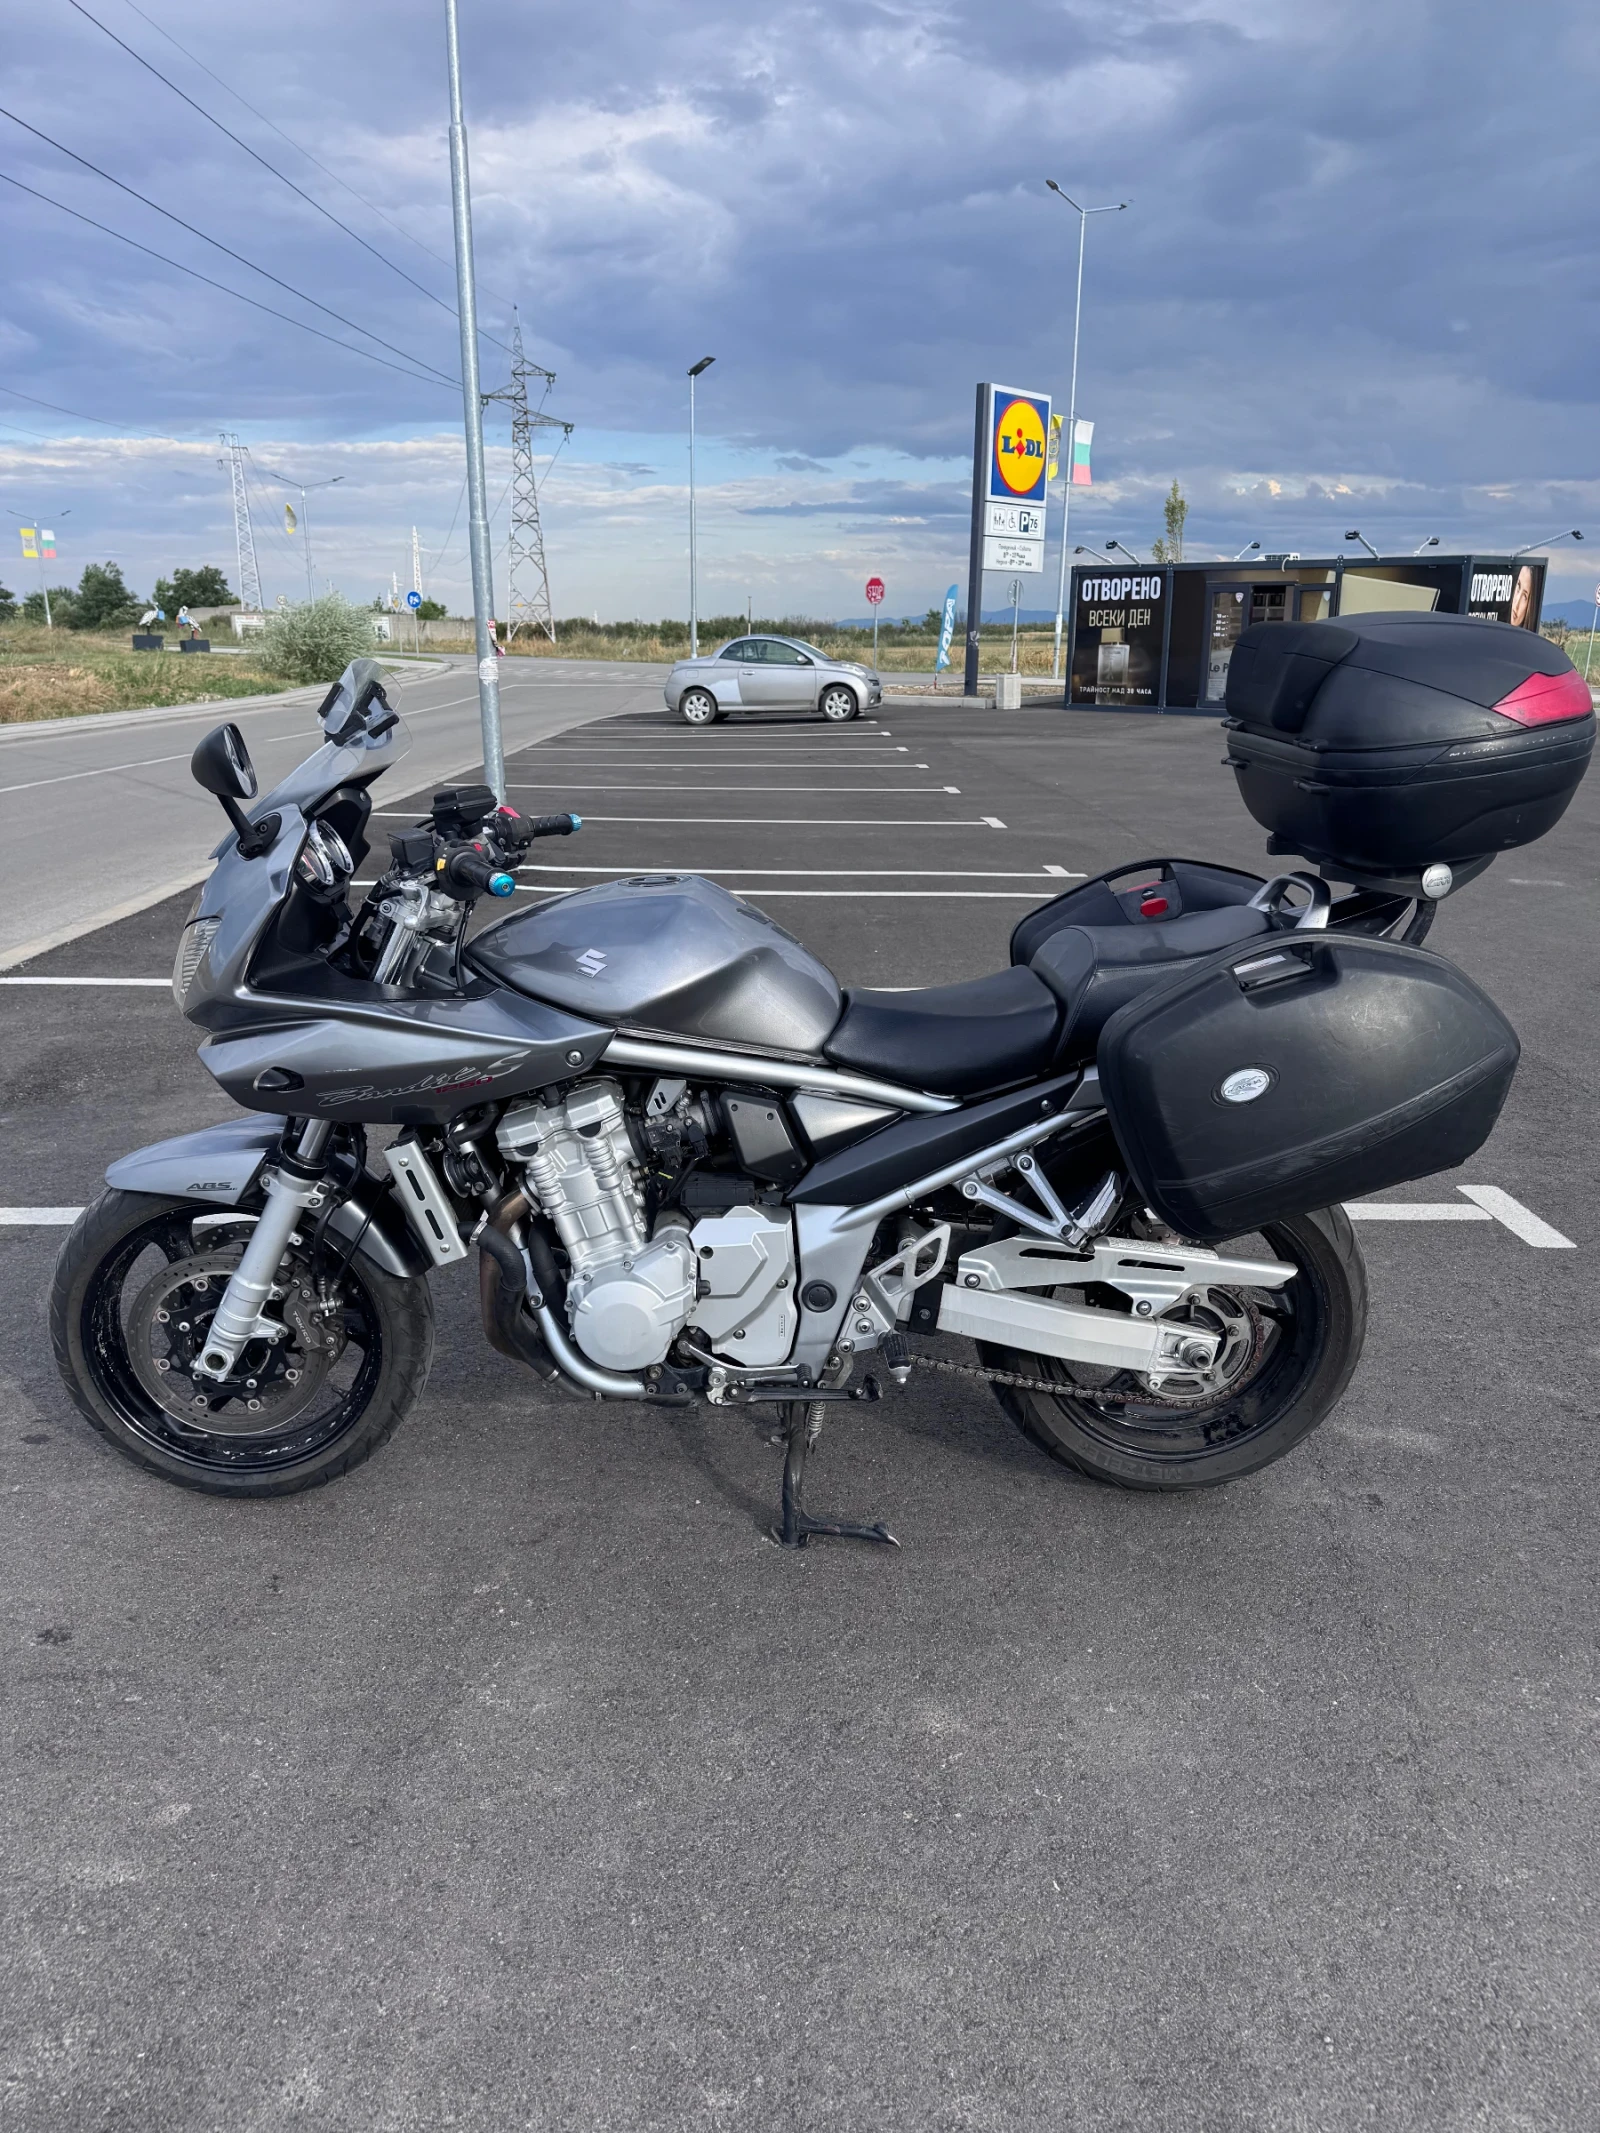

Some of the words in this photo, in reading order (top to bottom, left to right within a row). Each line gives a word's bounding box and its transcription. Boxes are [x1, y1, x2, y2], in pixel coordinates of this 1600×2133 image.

[1030, 518, 1038, 529] 76
[867, 585, 884, 597] STOP
[1082, 576, 1161, 601] ОТВОРЕНО
[1471, 574, 1513, 602] ОТВОРЕНО
[1089, 609, 1125, 627] ВСЕКИ
[1128, 609, 1151, 628] ДЕН
[1079, 685, 1110, 694] ТРАЙНОСТ
[1112, 686, 1125, 695] НАД
[434, 1076, 493, 1094] 1250
[186, 1182, 233, 1191] ABS
[292, 1310, 311, 1344] TOKICO
